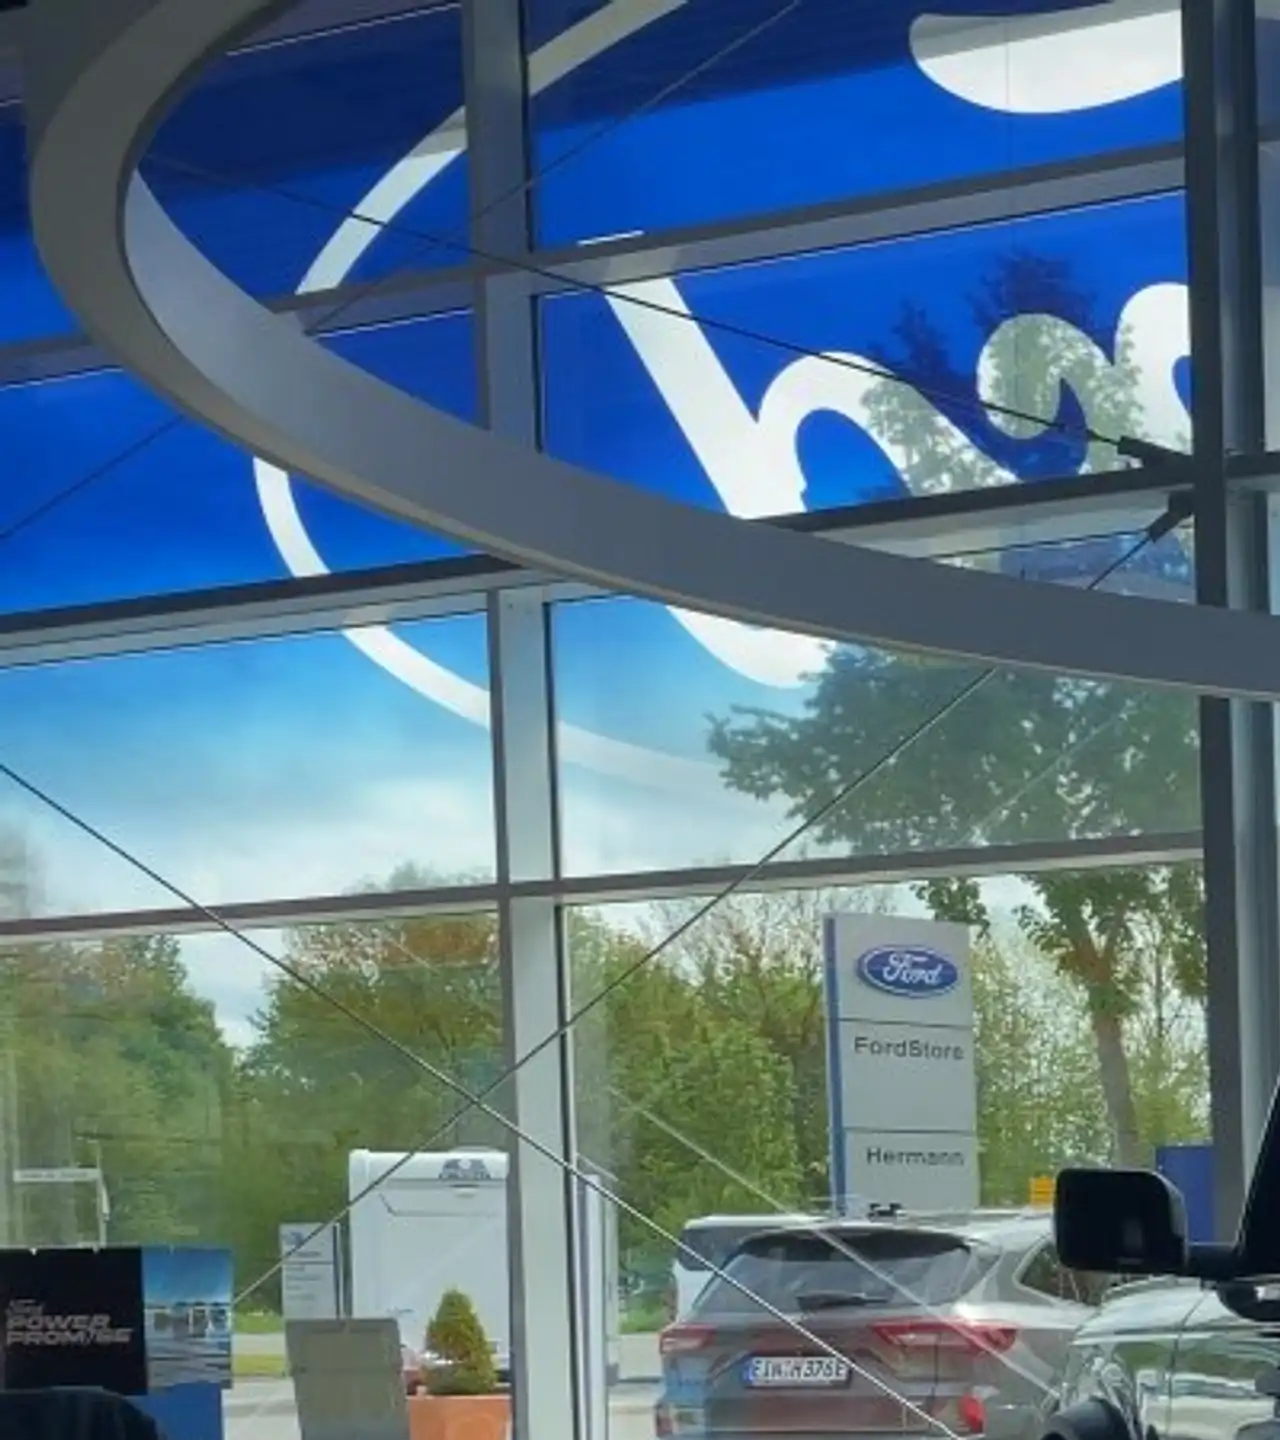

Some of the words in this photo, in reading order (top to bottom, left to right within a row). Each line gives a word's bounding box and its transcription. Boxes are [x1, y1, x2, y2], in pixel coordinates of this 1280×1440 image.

[882, 952, 943, 985] Ford
[854, 1036, 965, 1061] FordStore
[866, 1147, 966, 1167] Hermann
[6, 1312, 112, 1330] POWER
[6, 1328, 133, 1346] PROMISE
